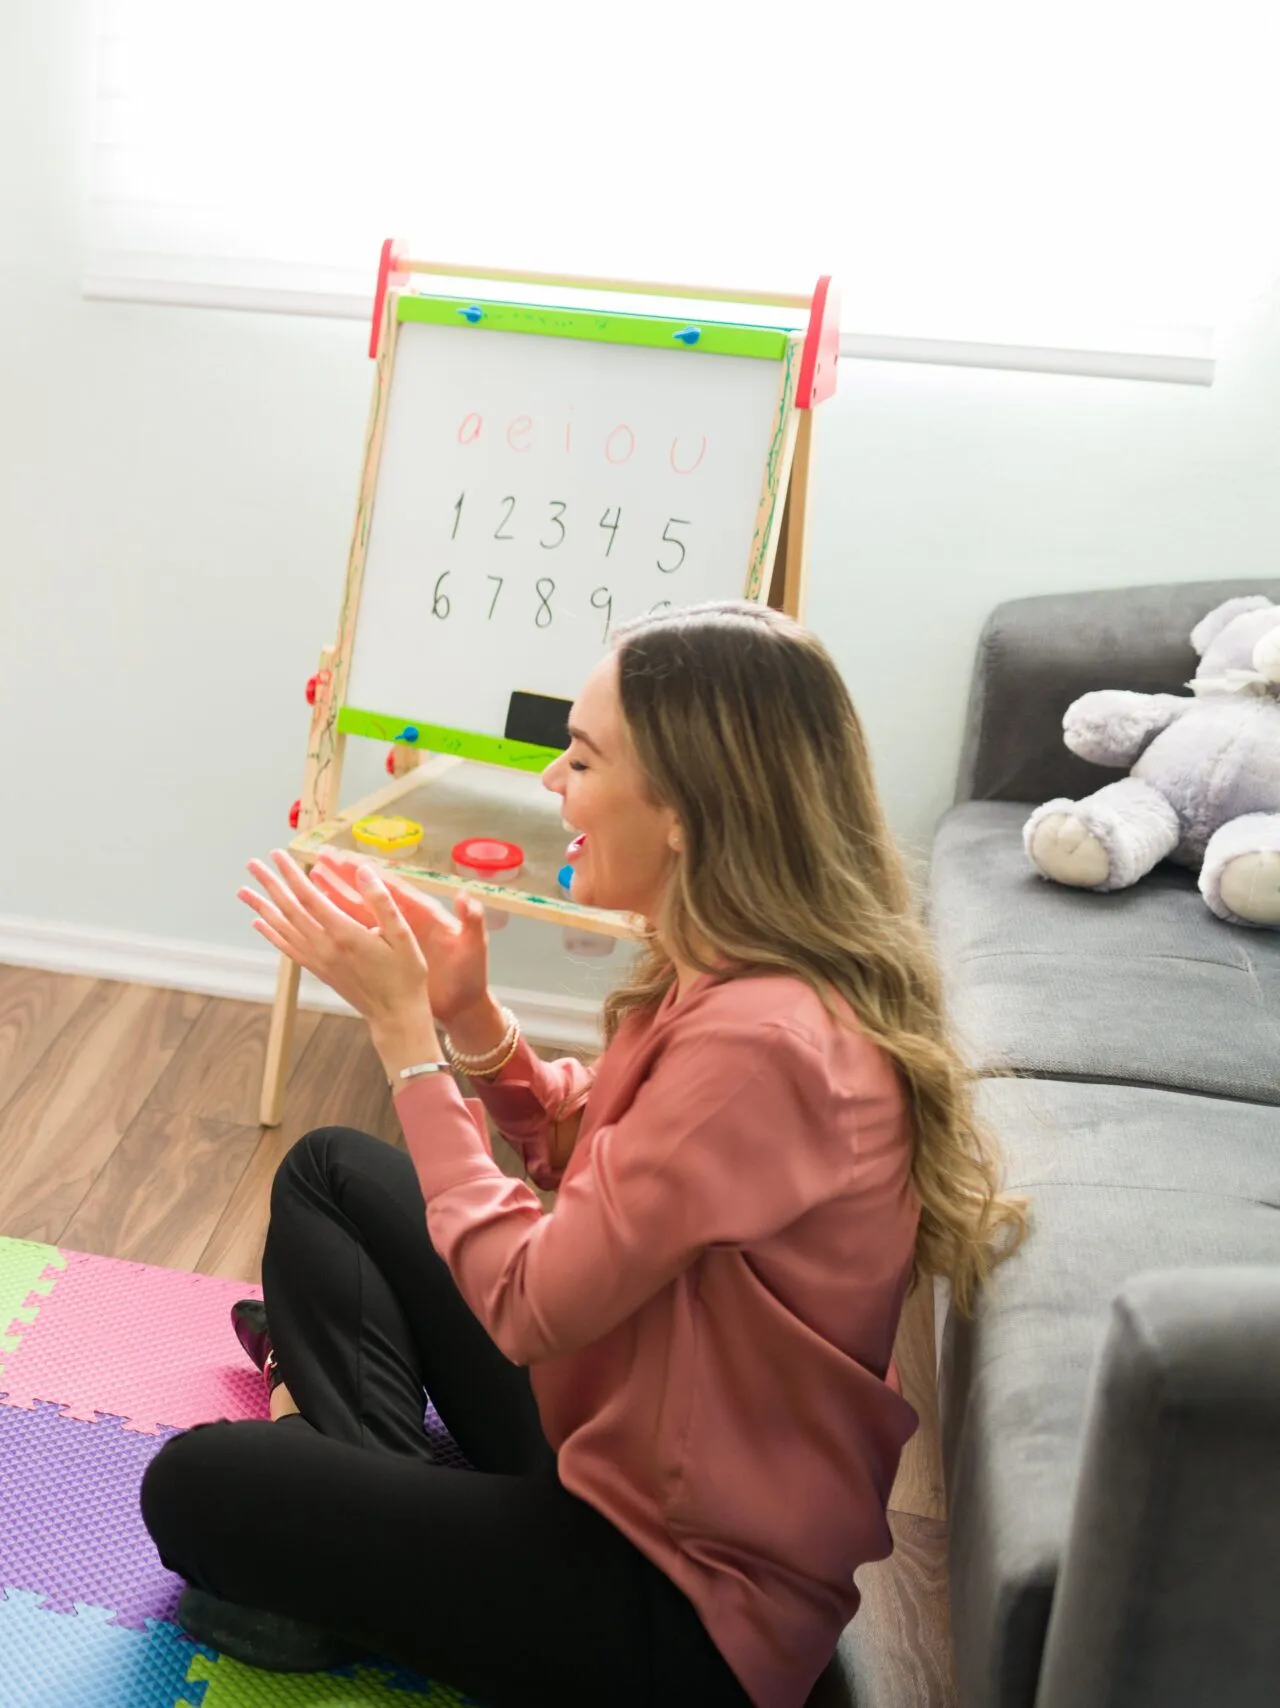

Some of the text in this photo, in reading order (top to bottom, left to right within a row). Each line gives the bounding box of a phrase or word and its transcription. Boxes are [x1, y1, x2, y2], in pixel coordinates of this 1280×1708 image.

[457, 411, 483, 446] a
[506, 415, 533, 453] e
[451, 491, 692, 574] 1 2 3 4 5
[431, 570, 613, 646] 6 7 8 9
